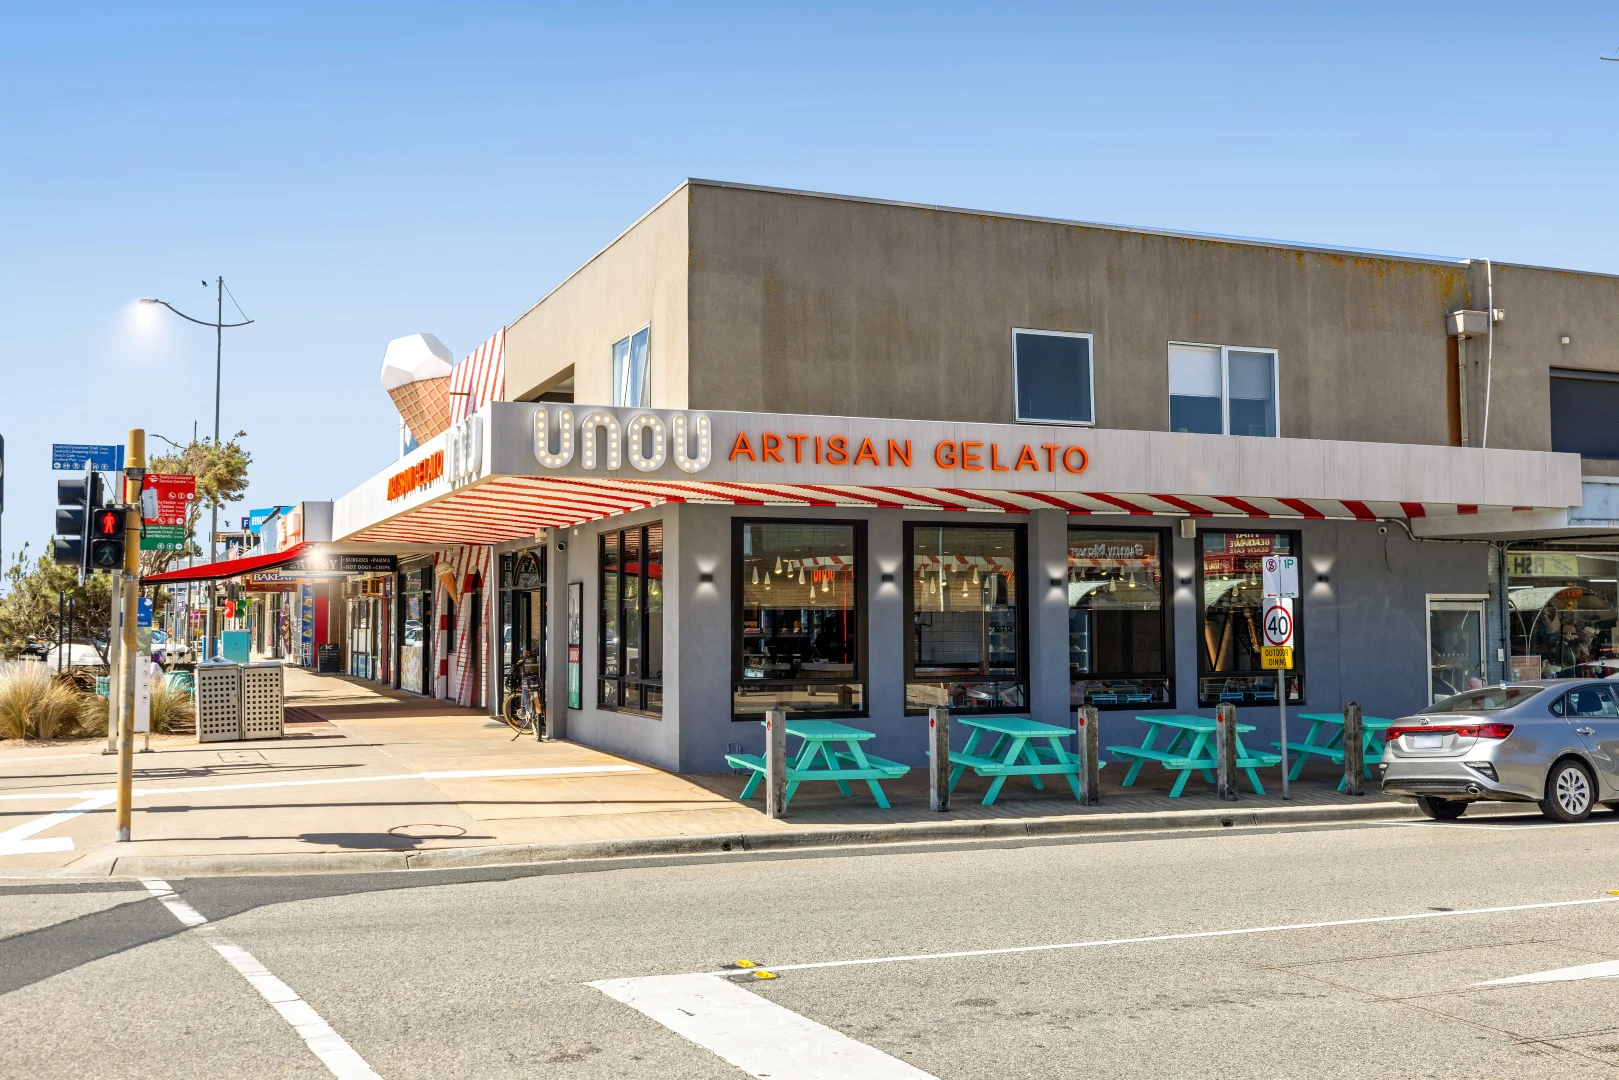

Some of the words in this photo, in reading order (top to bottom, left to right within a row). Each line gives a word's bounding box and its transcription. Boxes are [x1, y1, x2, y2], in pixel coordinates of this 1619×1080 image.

[729, 431, 912, 467] ARTISAN
[934, 440, 1089, 474] GELATO
[415, 449, 444, 487] GELATO
[1284, 559, 1294, 569] 1P
[1268, 616, 1288, 635] 40
